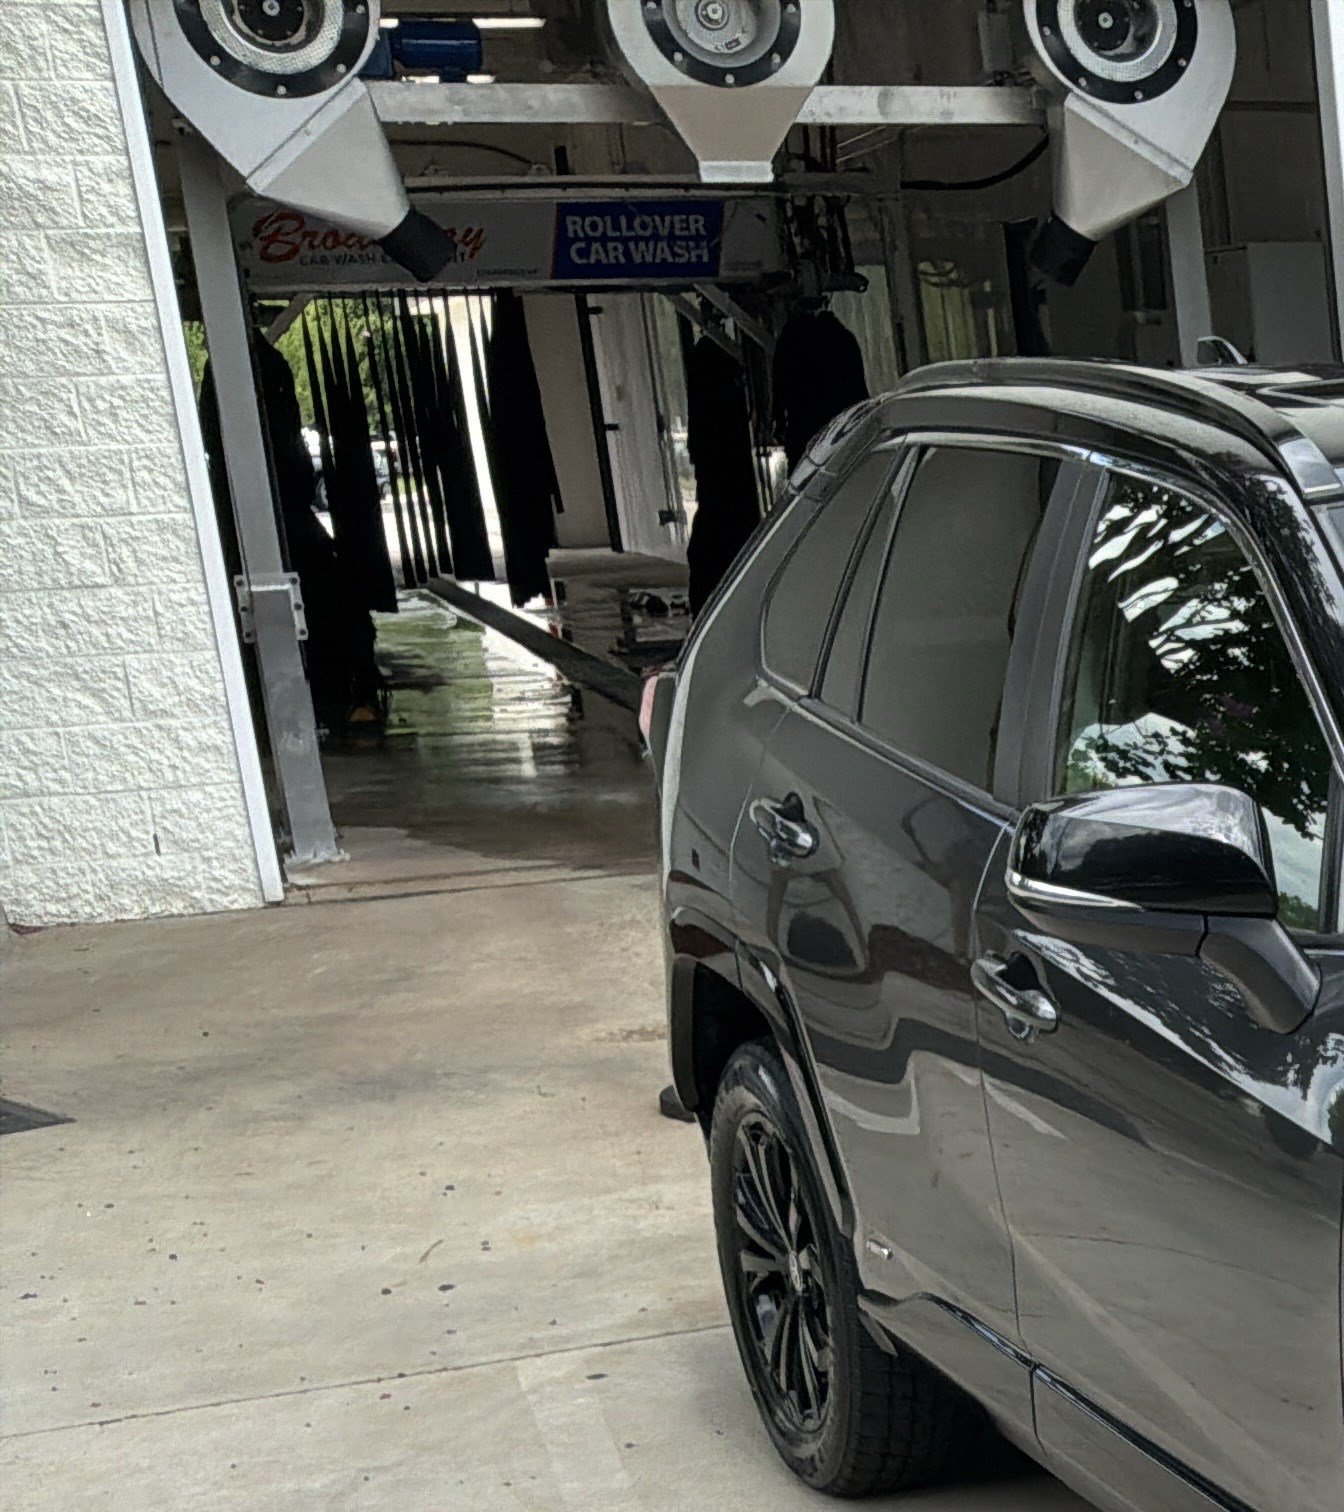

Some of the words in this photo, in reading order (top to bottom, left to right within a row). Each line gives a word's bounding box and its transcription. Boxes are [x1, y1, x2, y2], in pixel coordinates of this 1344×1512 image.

[252, 211, 486, 263] Broay
[565, 214, 706, 238] ROLLOVER
[334, 251, 377, 264] WASH
[570, 241, 625, 264] CAR
[630, 239, 710, 263] WASH
